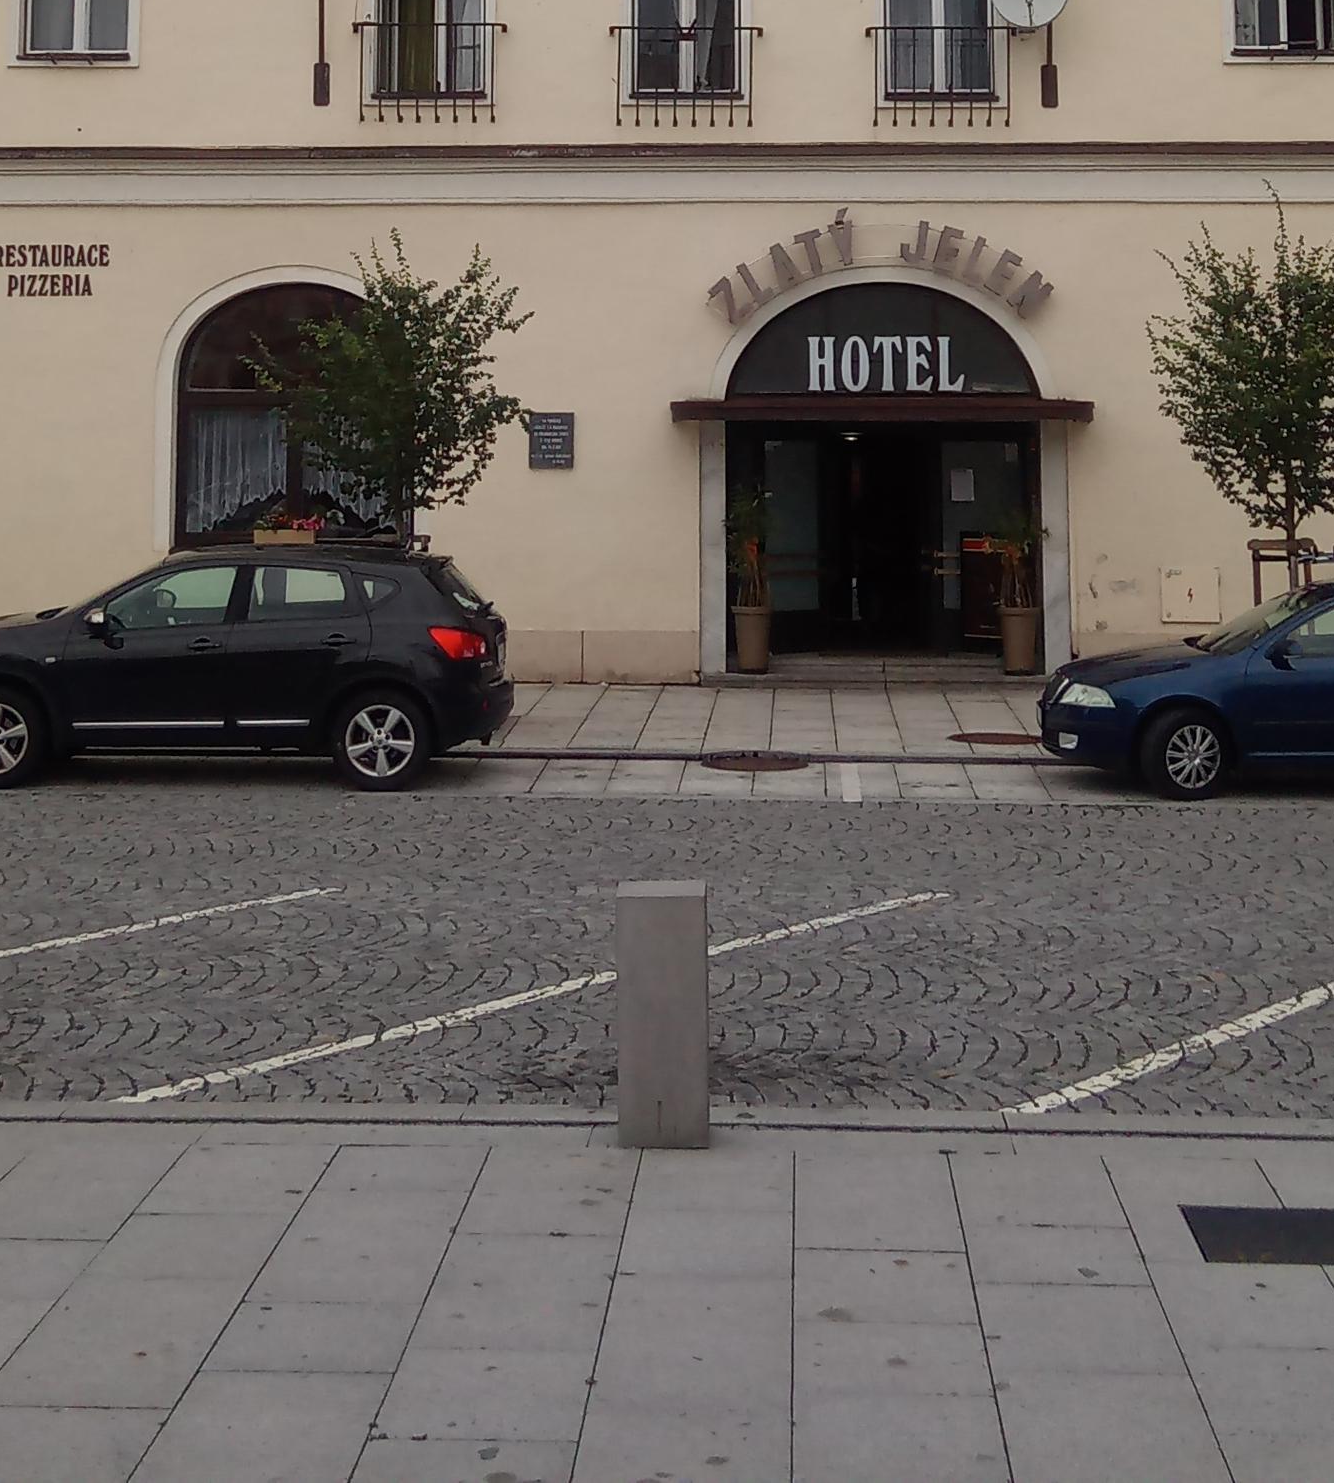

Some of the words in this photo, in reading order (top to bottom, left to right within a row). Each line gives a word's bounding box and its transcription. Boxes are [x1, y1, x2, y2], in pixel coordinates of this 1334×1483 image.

[7, 273, 93, 298] PIZZERIA
[706, 206, 854, 325] ZLATÝ
[899, 219, 1055, 320] JELEN
[807, 335, 966, 392] HOTEL
